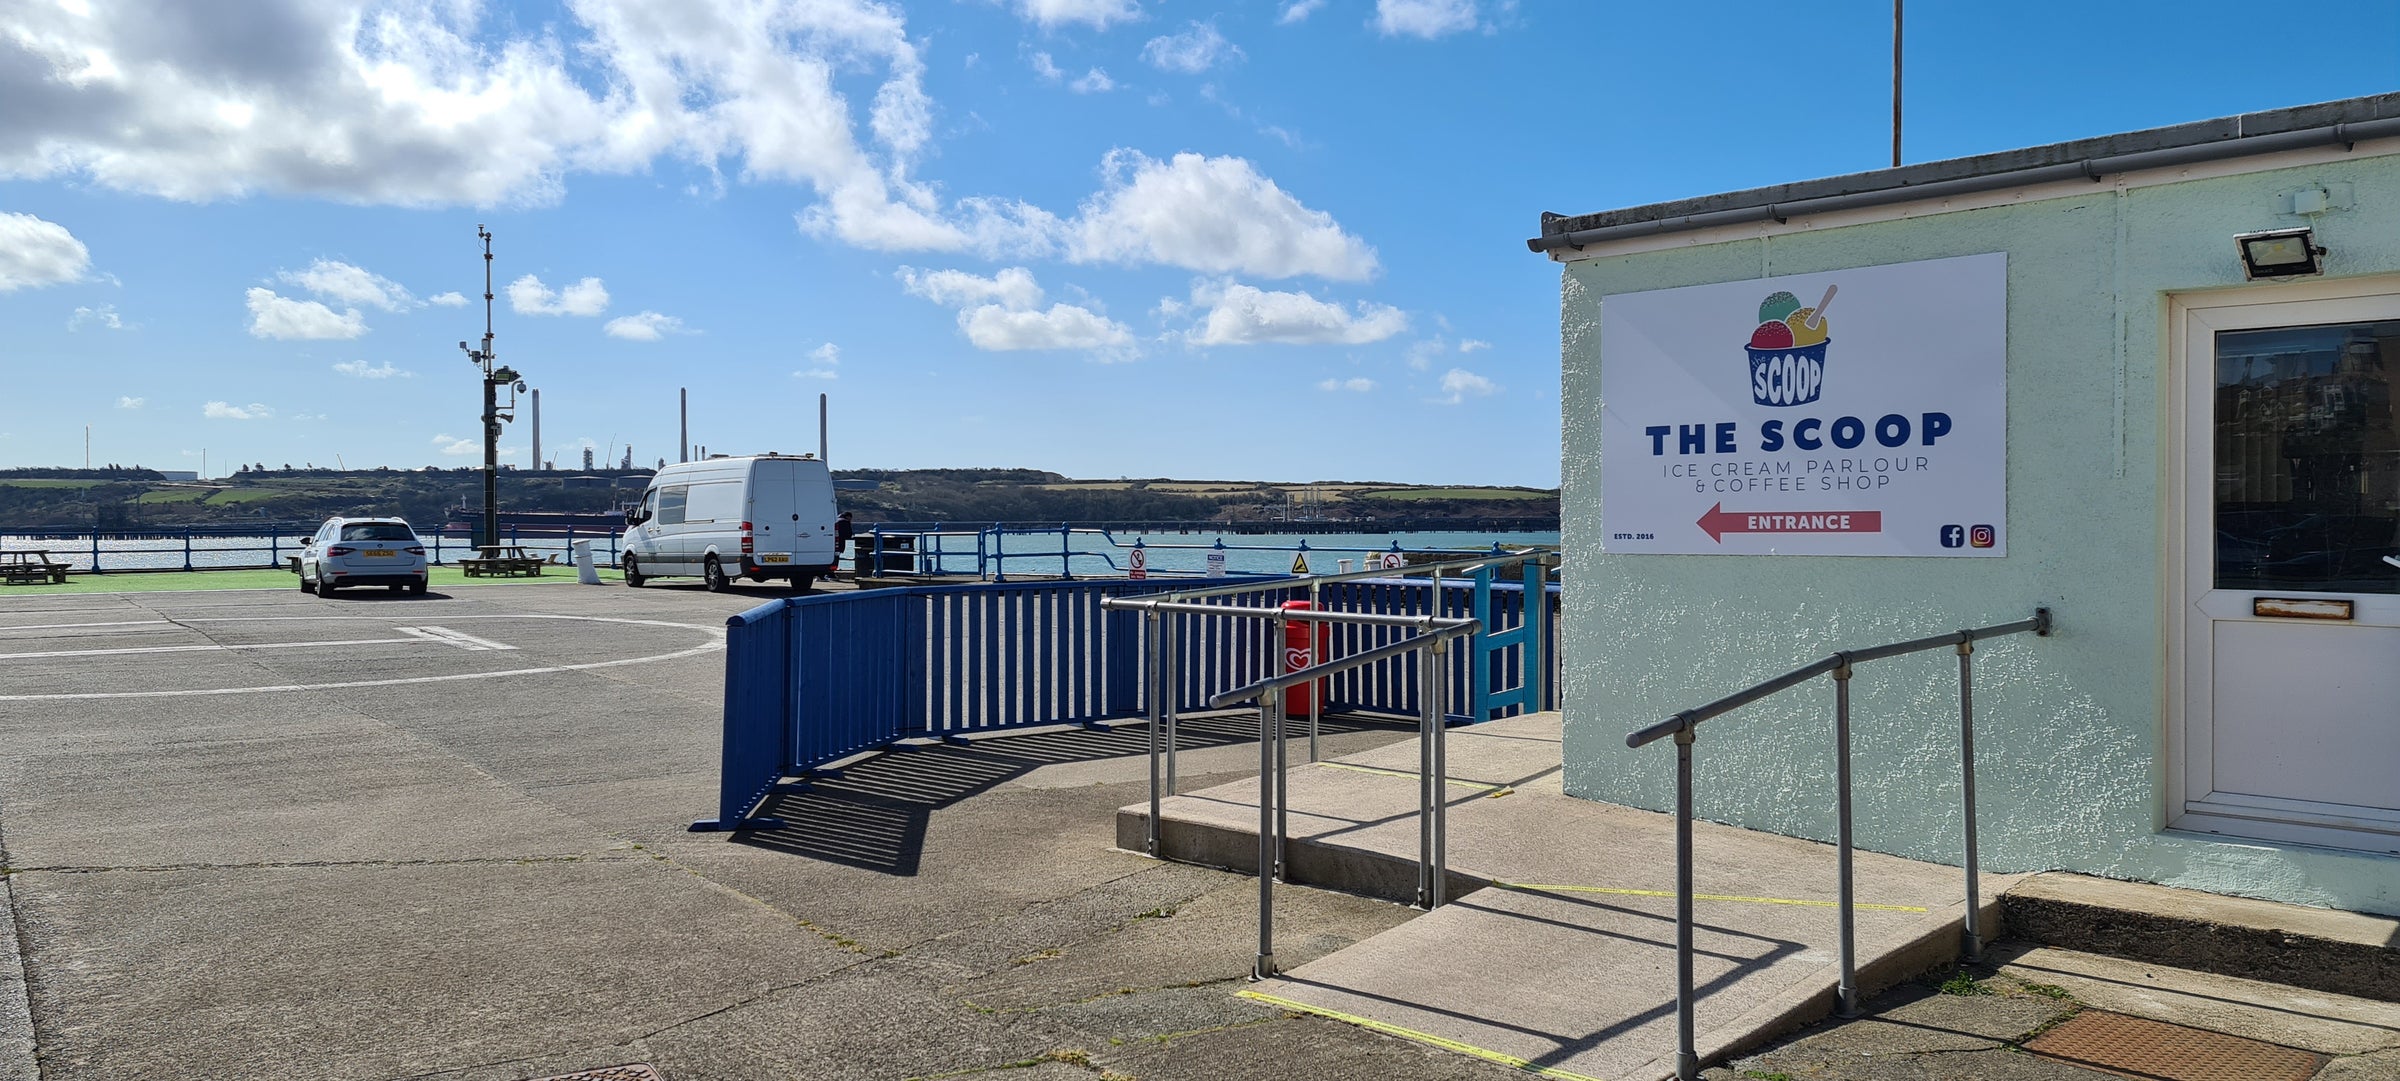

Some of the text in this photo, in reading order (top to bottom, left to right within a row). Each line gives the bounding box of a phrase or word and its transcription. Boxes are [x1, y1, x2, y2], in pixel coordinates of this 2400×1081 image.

[1754, 353, 1821, 405] SCOOP
[1646, 412, 1952, 456] THE SCOOP
[1662, 456, 1929, 478] ICE CREAM PARLOUR
[1695, 475, 1891, 493] & COFFEE SHOP
[1747, 514, 1851, 530] ENTRANCE
